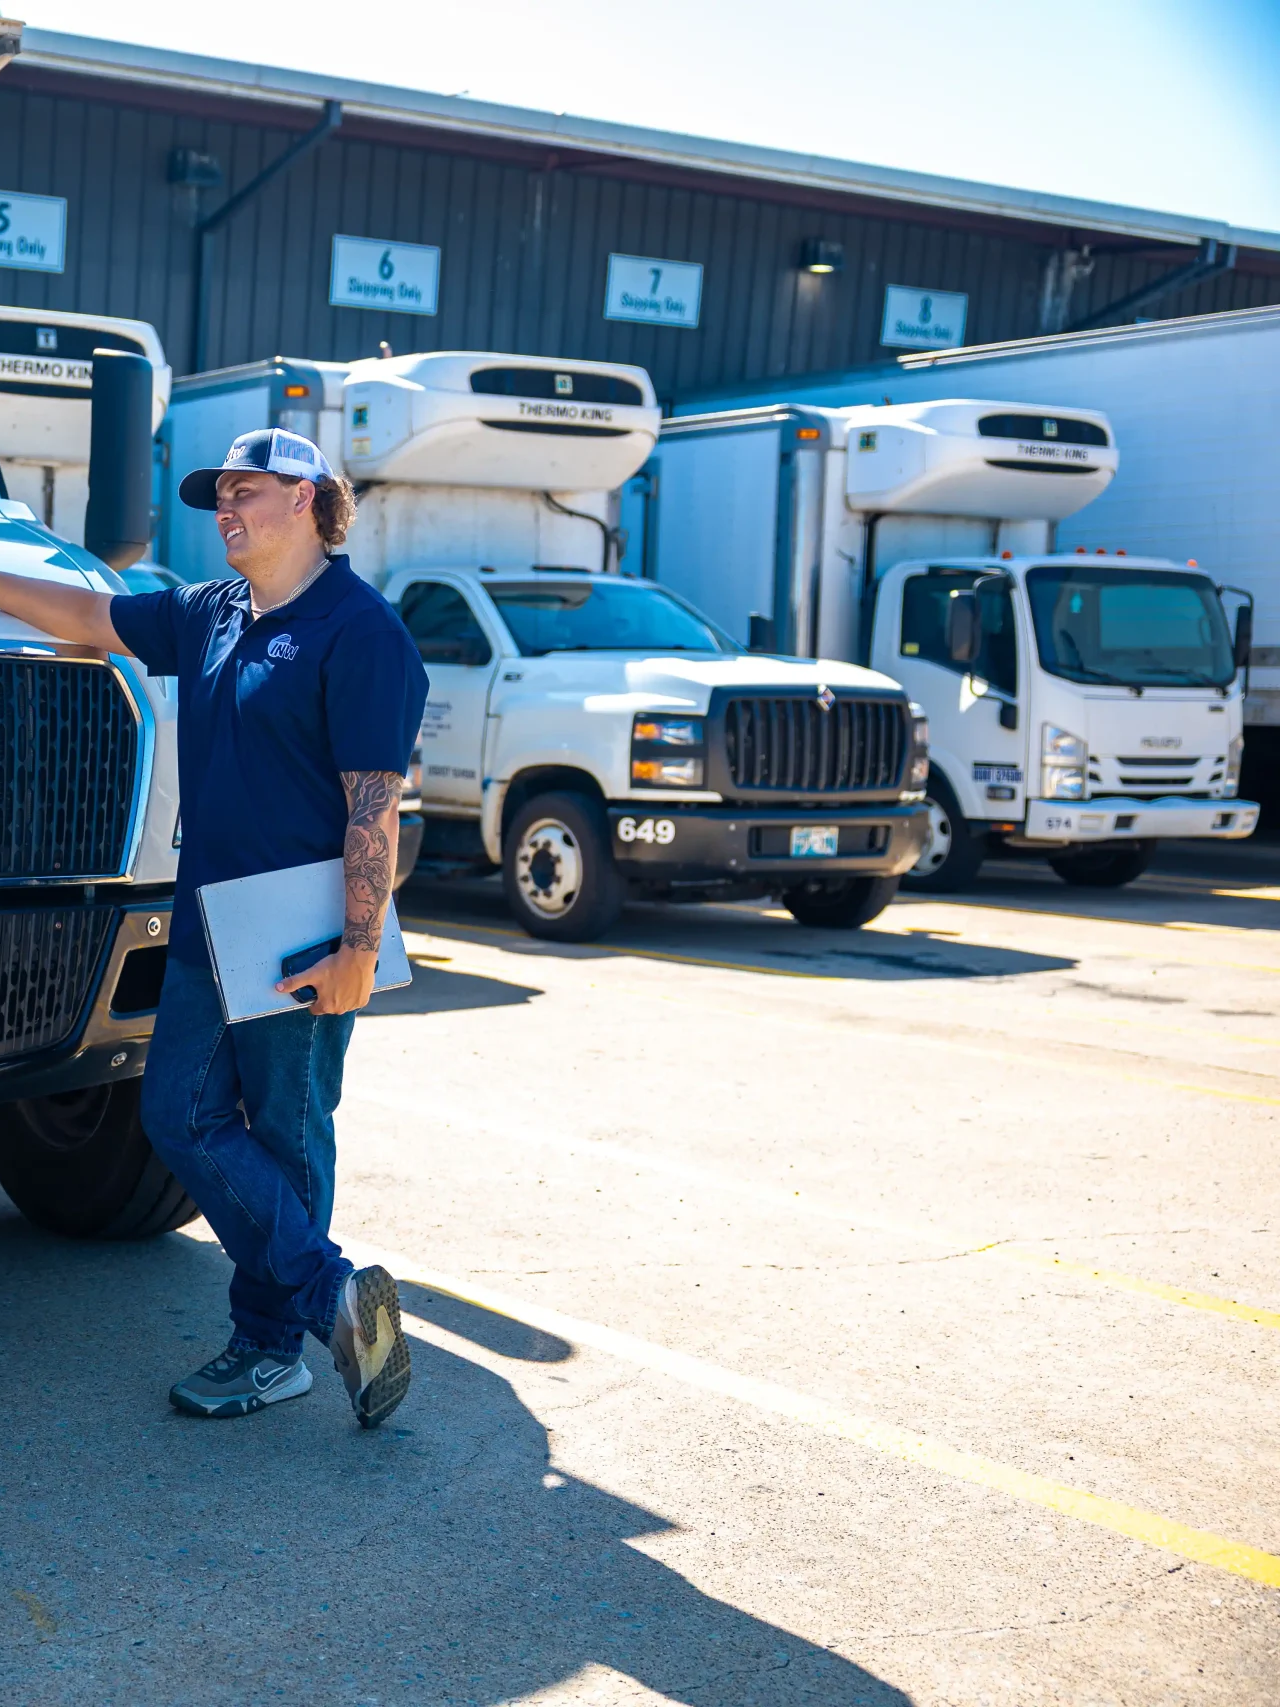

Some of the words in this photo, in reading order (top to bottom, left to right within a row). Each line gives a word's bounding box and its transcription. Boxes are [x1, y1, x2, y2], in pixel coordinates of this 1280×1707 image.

[16, 236, 47, 260] Only
[379, 247, 394, 280] 6
[648, 267, 662, 295] 7
[919, 295, 932, 324] 8
[66, 364, 92, 379] KIN
[519, 403, 579, 419] THERMO
[580, 408, 614, 421] KING
[618, 817, 675, 844] 649
